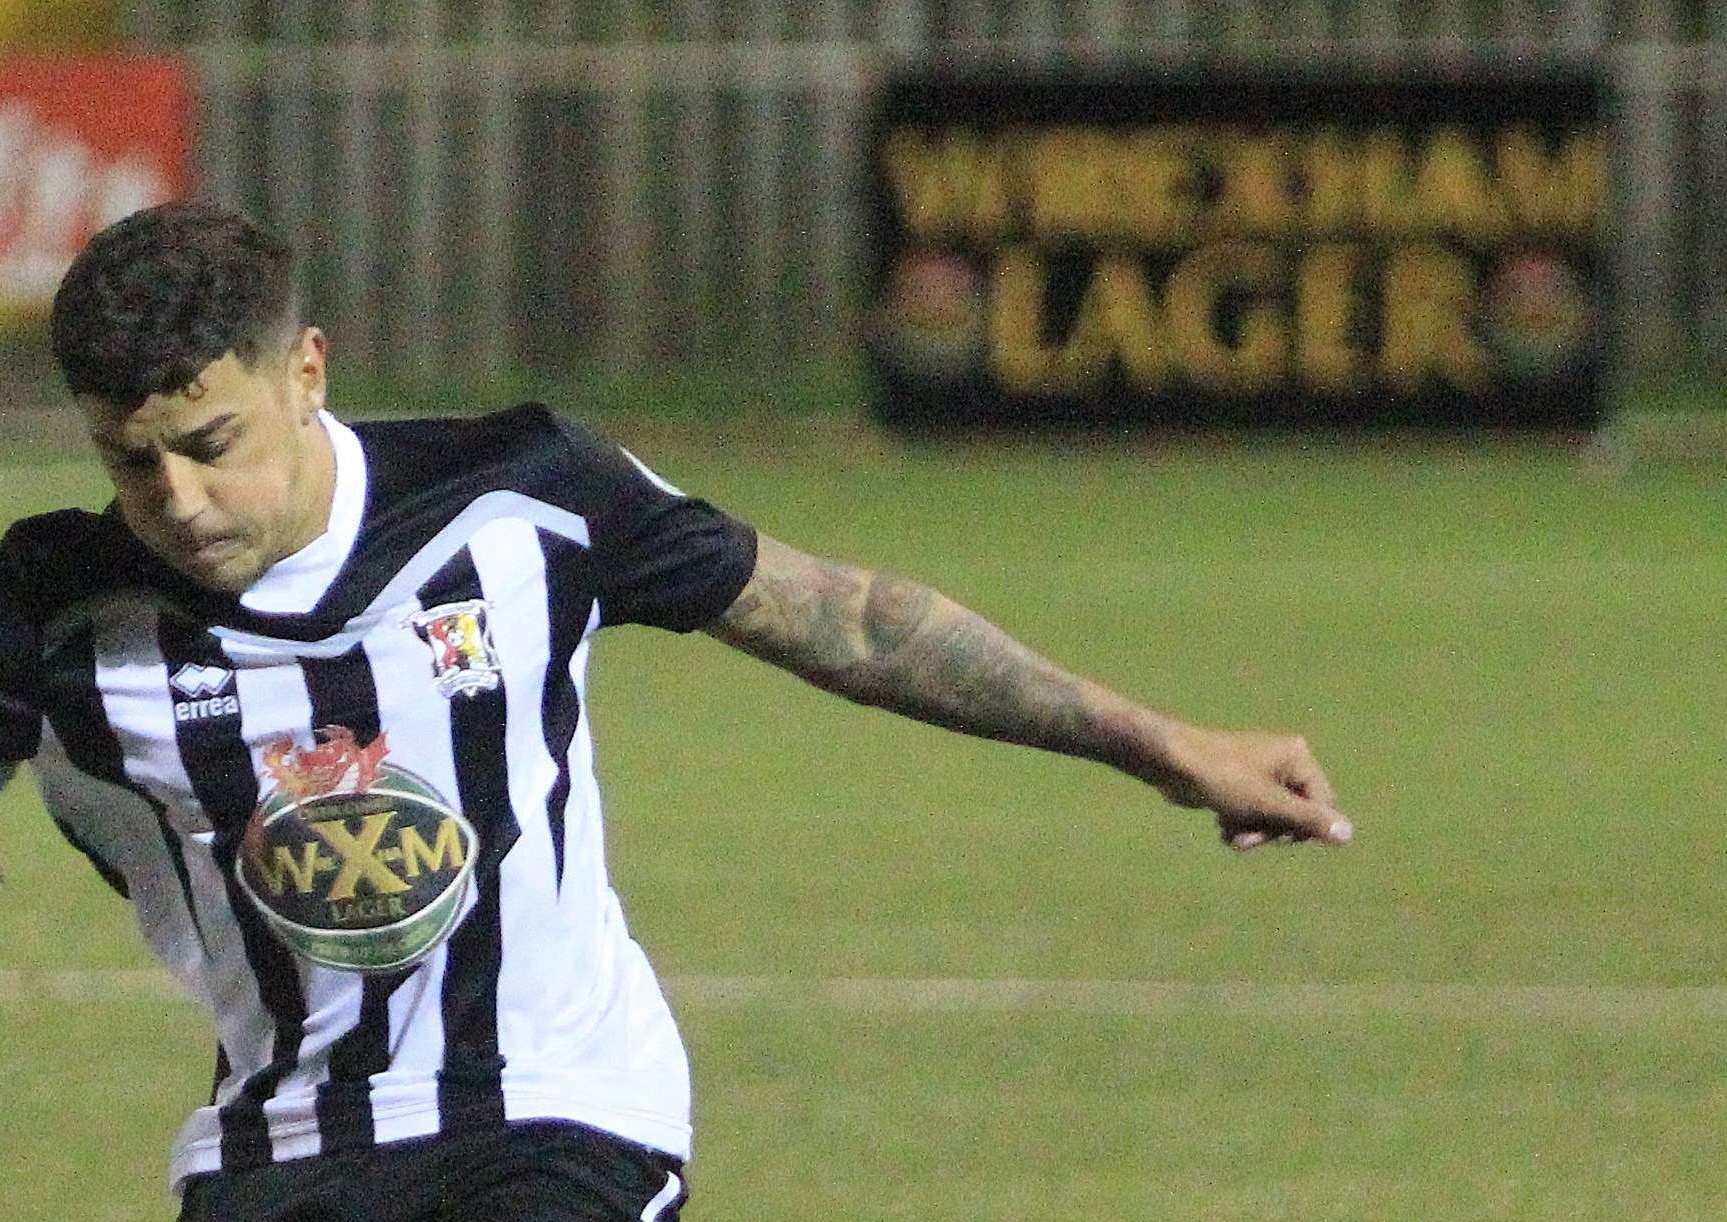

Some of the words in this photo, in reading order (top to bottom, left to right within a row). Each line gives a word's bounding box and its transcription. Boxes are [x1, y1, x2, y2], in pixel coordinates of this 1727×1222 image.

[883, 122, 1609, 238] WREXHAM
[985, 238, 1485, 394] LAGER
[175, 695, 239, 721] errea
